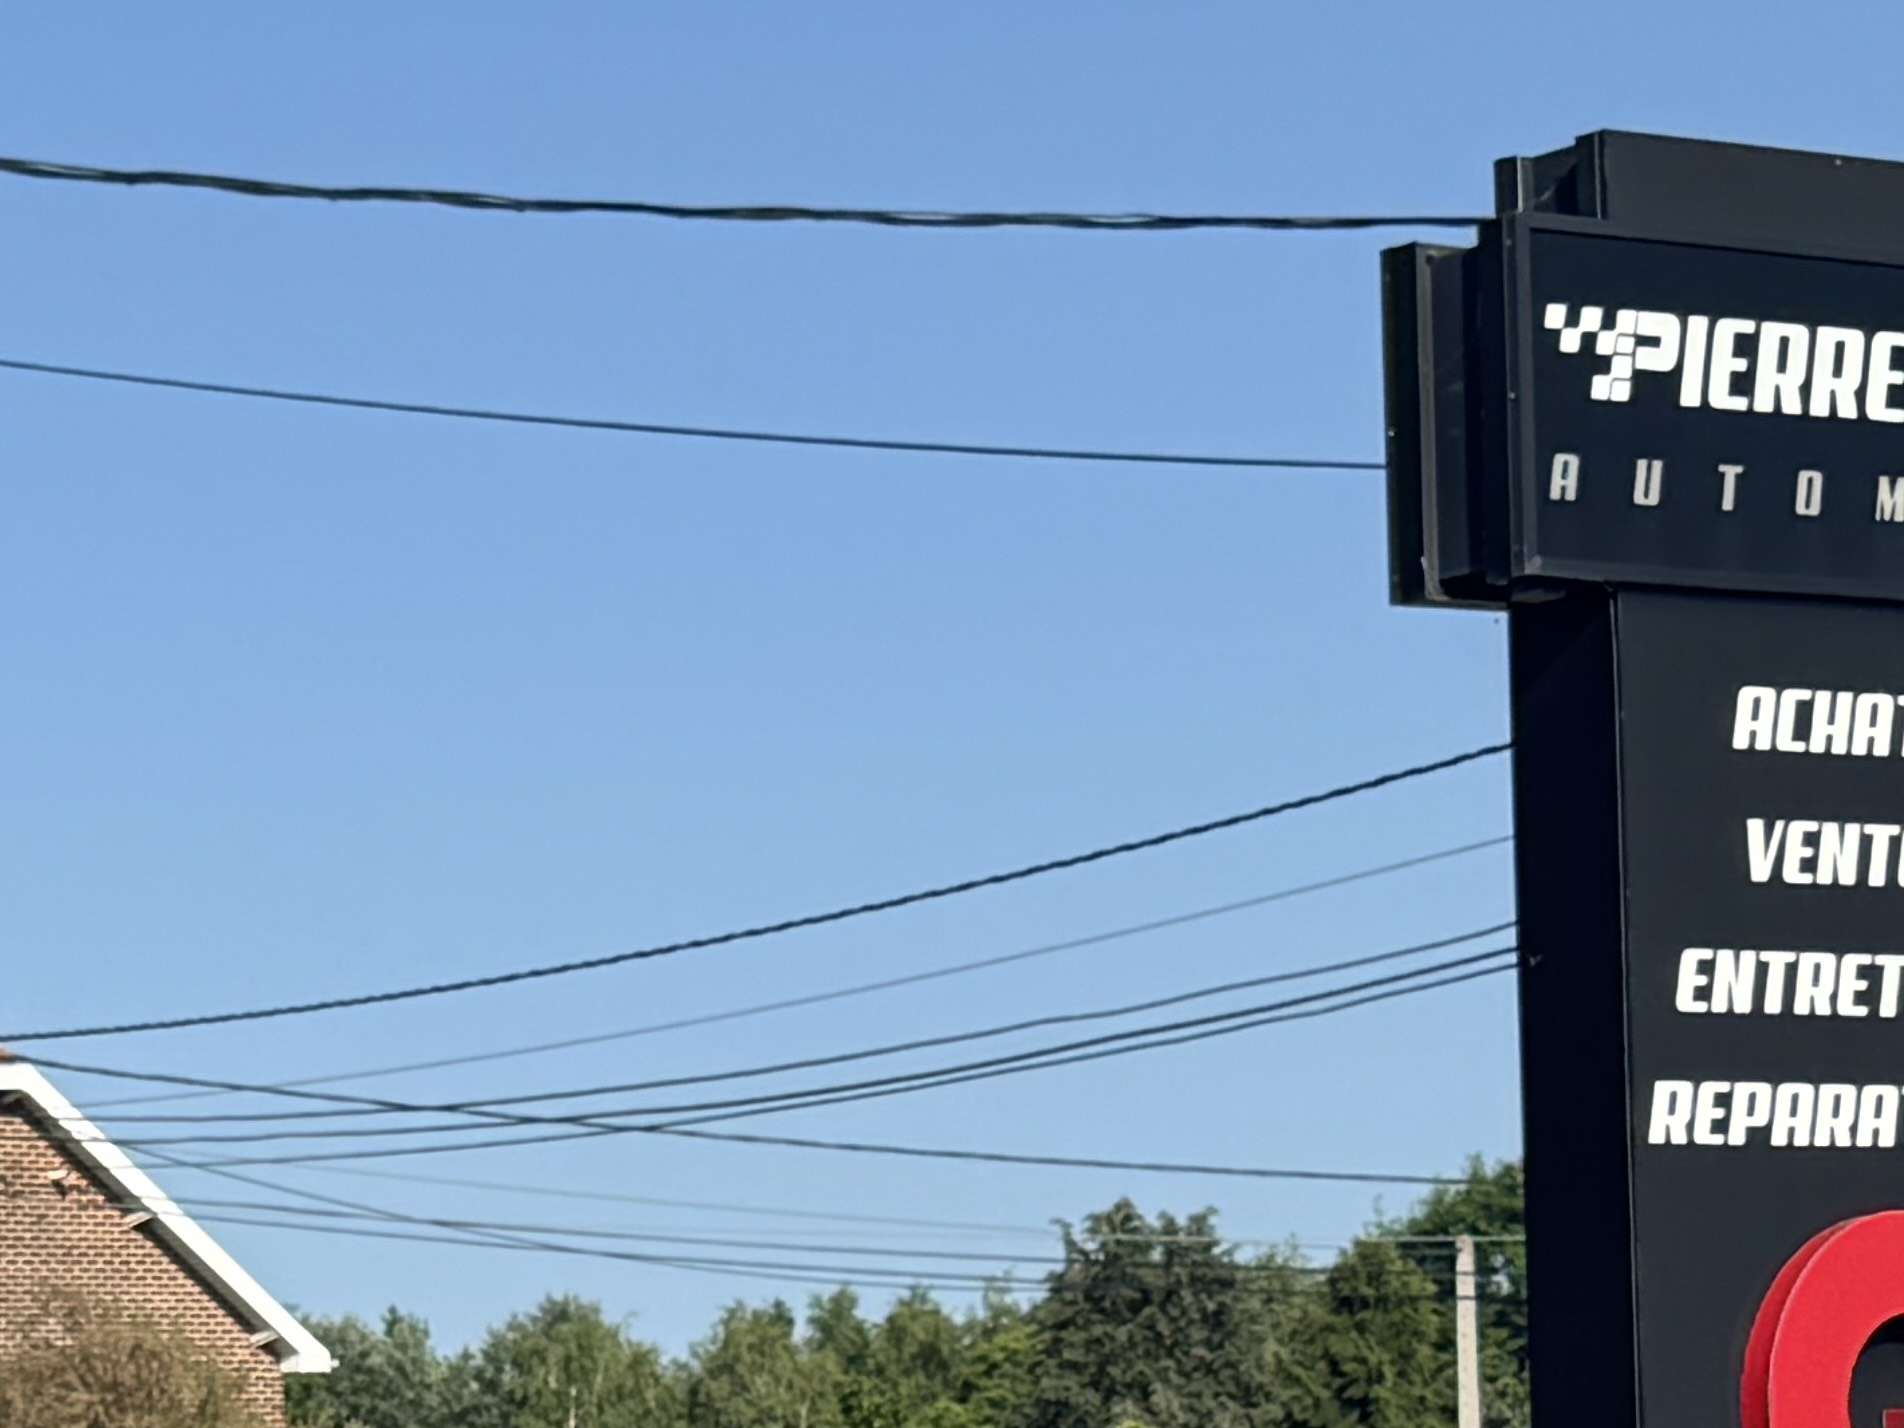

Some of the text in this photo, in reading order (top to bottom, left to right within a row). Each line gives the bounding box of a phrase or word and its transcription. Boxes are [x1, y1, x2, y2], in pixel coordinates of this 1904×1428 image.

[1590, 308, 1904, 424] PIERRE
[1732, 685, 1904, 758] ACHA
[1746, 818, 1904, 888] VENT
[1648, 1080, 1904, 1148] REPARA
